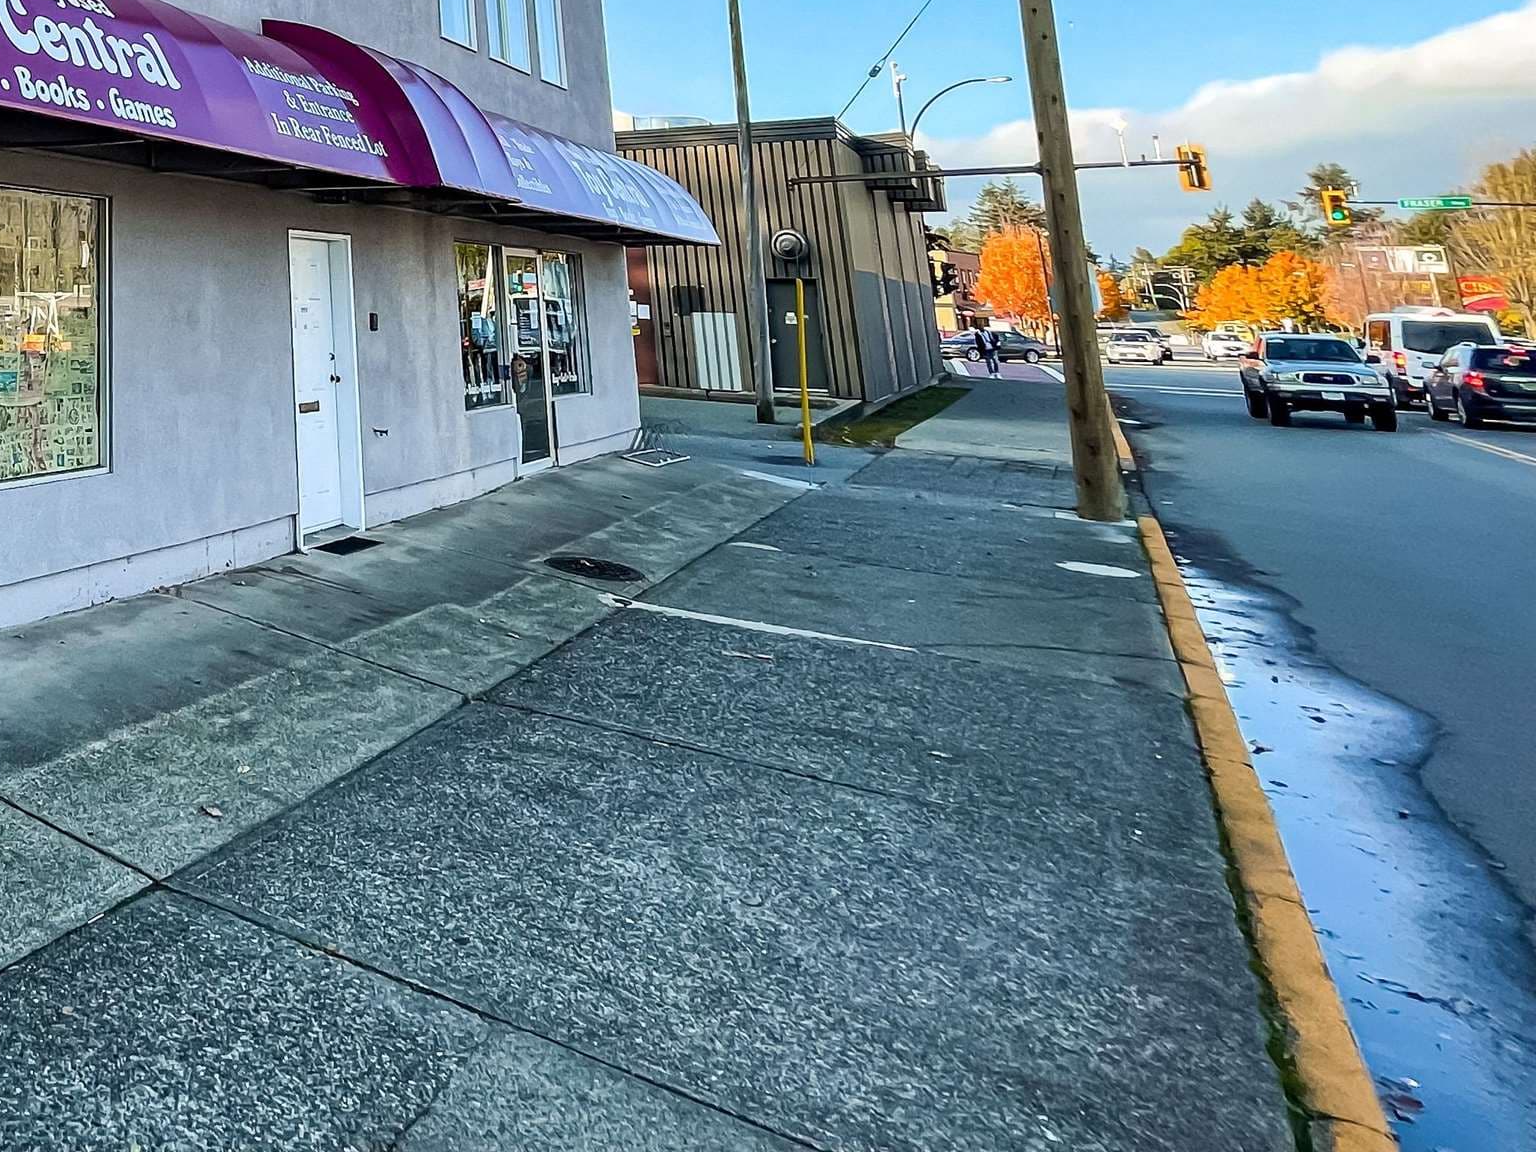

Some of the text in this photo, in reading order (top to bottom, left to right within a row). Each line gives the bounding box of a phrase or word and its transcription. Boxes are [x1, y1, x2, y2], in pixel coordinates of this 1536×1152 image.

[13, 65, 92, 112] Books
[108, 87, 178, 129] Games
[243, 56, 360, 107] Additional Parking
[282, 89, 355, 123] & Entrance
[270, 112, 389, 158] In Rear Fenced Lot
